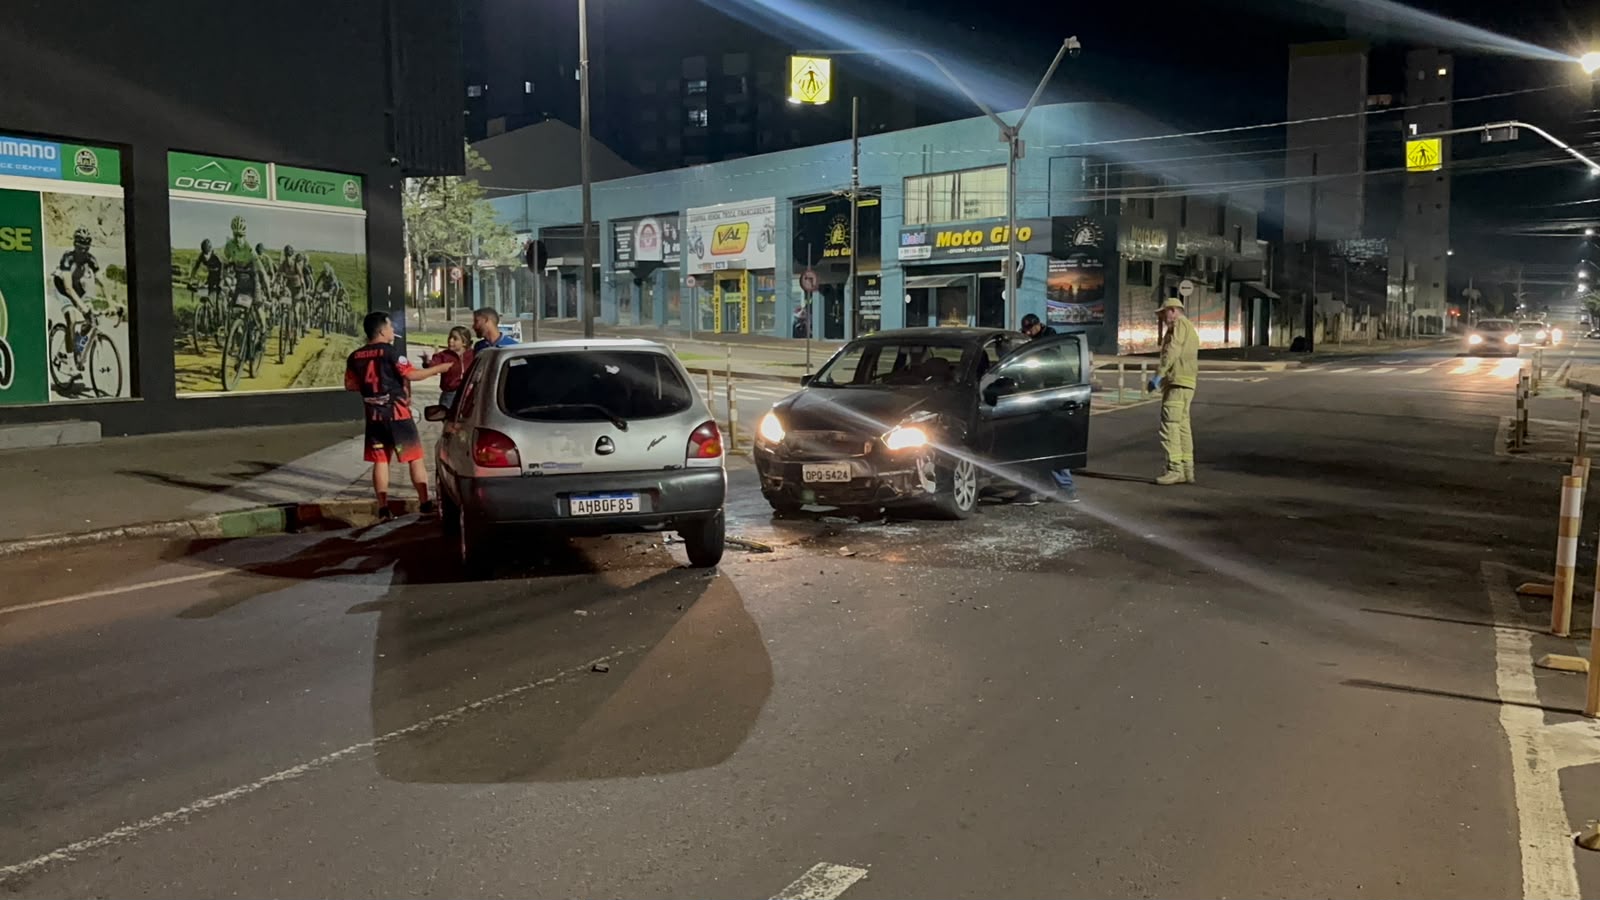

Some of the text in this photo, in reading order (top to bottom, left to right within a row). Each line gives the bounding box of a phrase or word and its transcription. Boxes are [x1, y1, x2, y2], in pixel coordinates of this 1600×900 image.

[16, 164, 56, 172] CENTER
[175, 177, 232, 192] OGGI
[277, 176, 335, 196] Wilier
[0, 227, 33, 251] SE
[717, 226, 741, 246] VAL
[936, 225, 1032, 248] Moto Gio
[366, 359, 379, 393] 4
[825, 470, 849, 480] 5424
